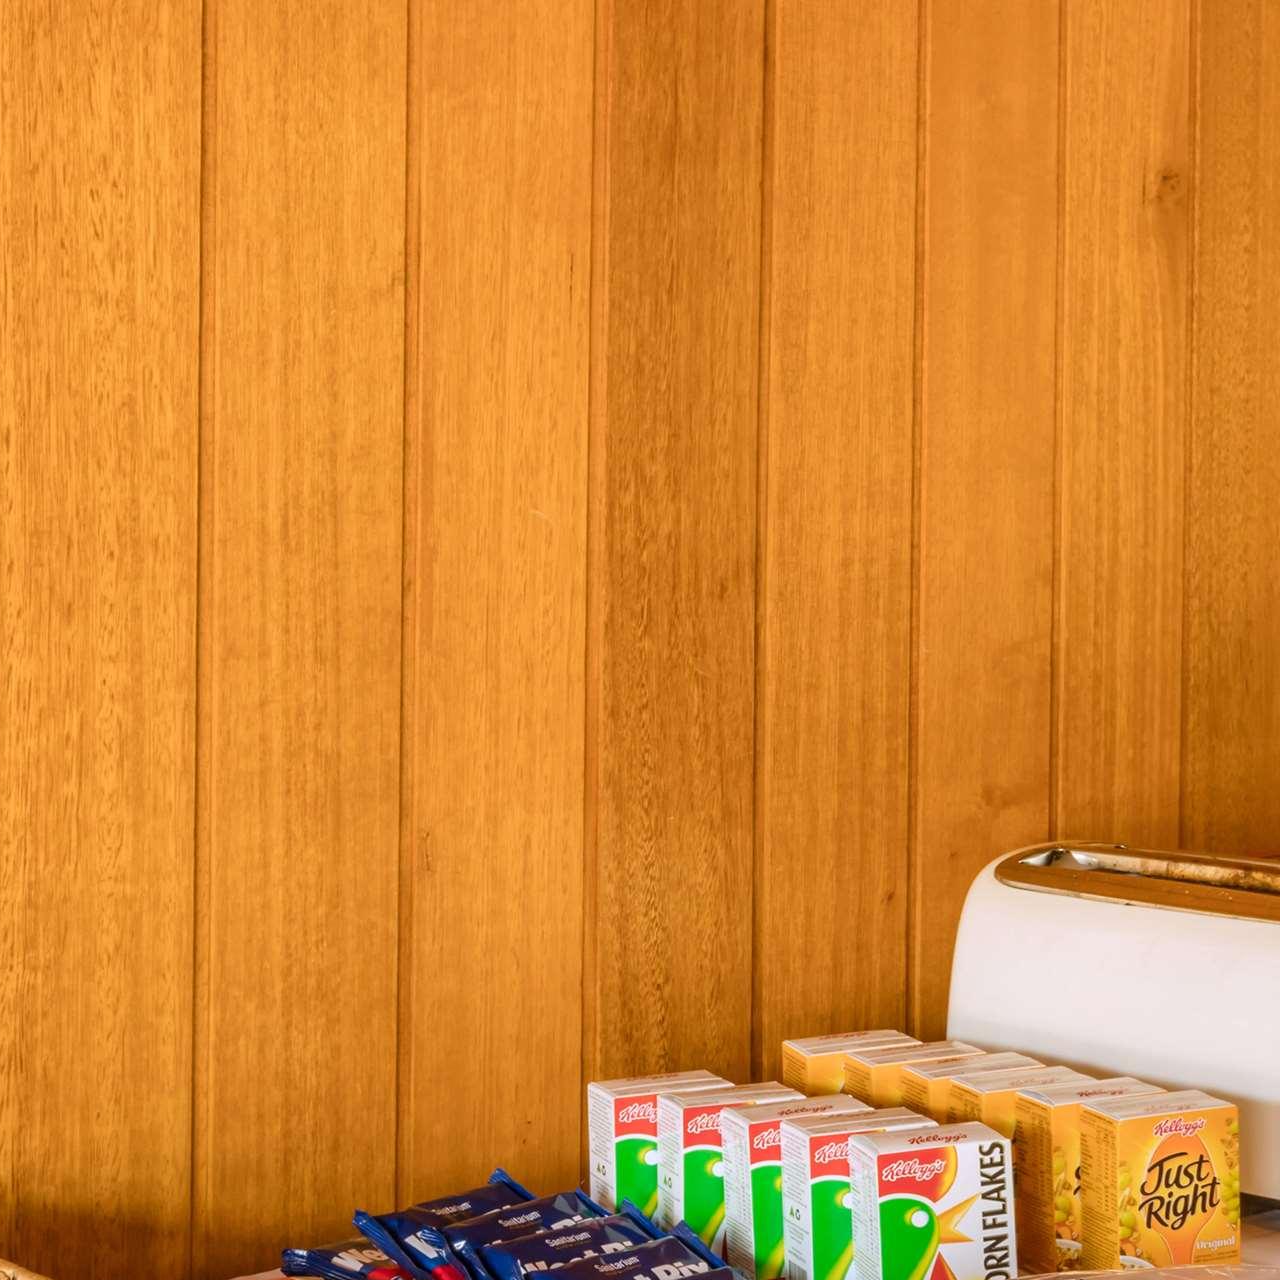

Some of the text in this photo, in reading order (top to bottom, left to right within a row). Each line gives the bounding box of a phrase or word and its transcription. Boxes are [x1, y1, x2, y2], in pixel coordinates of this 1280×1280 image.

[1153, 1116, 1207, 1138] Kellogg's
[882, 1158, 945, 1182] Kellogg's
[979, 1141, 1008, 1231] FLAKES
[1139, 1151, 1210, 1196] Just
[1138, 1177, 1220, 1230] Right
